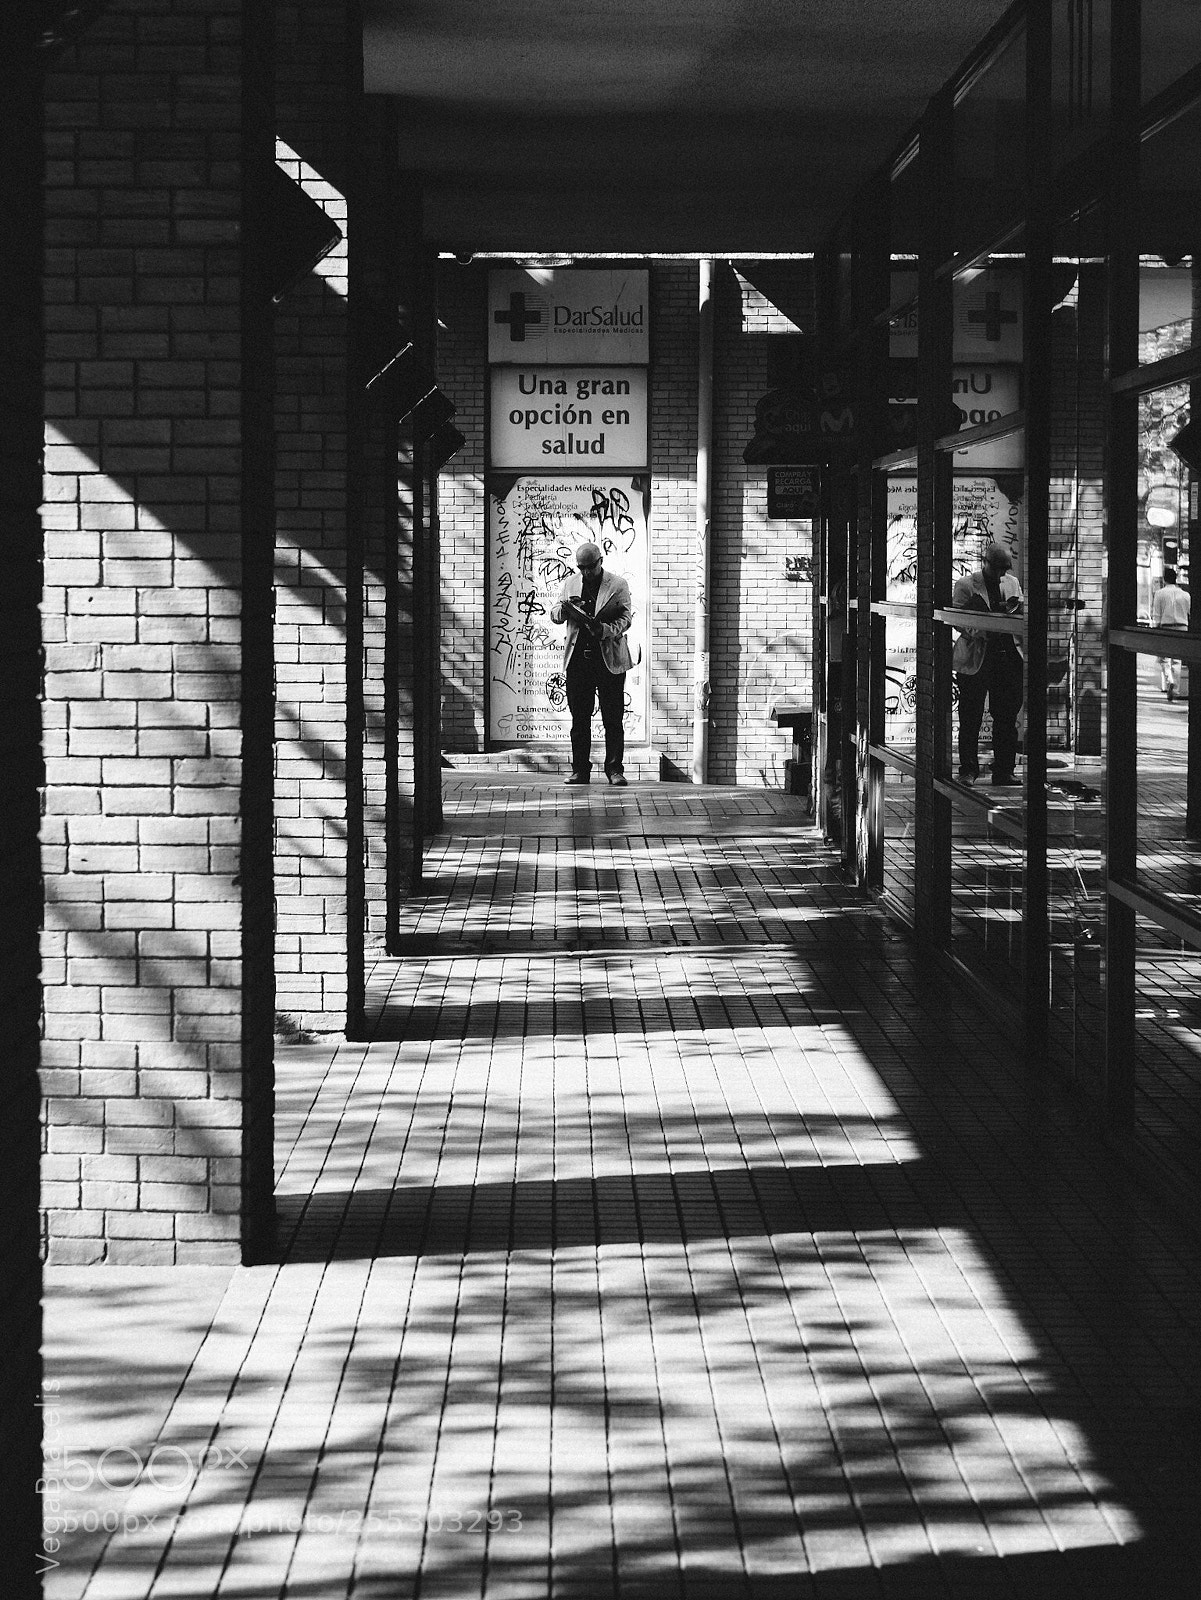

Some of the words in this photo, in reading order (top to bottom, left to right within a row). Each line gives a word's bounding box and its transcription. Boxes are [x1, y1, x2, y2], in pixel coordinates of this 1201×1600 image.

[553, 305, 644, 326] DarSalud
[518, 374, 568, 395] Una
[576, 379, 630, 400] gran
[509, 403, 592, 430] opción
[601, 409, 630, 425] en
[541, 433, 605, 455] salud
[517, 484, 572, 493] Especialidades
[574, 484, 606, 492] Médicas
